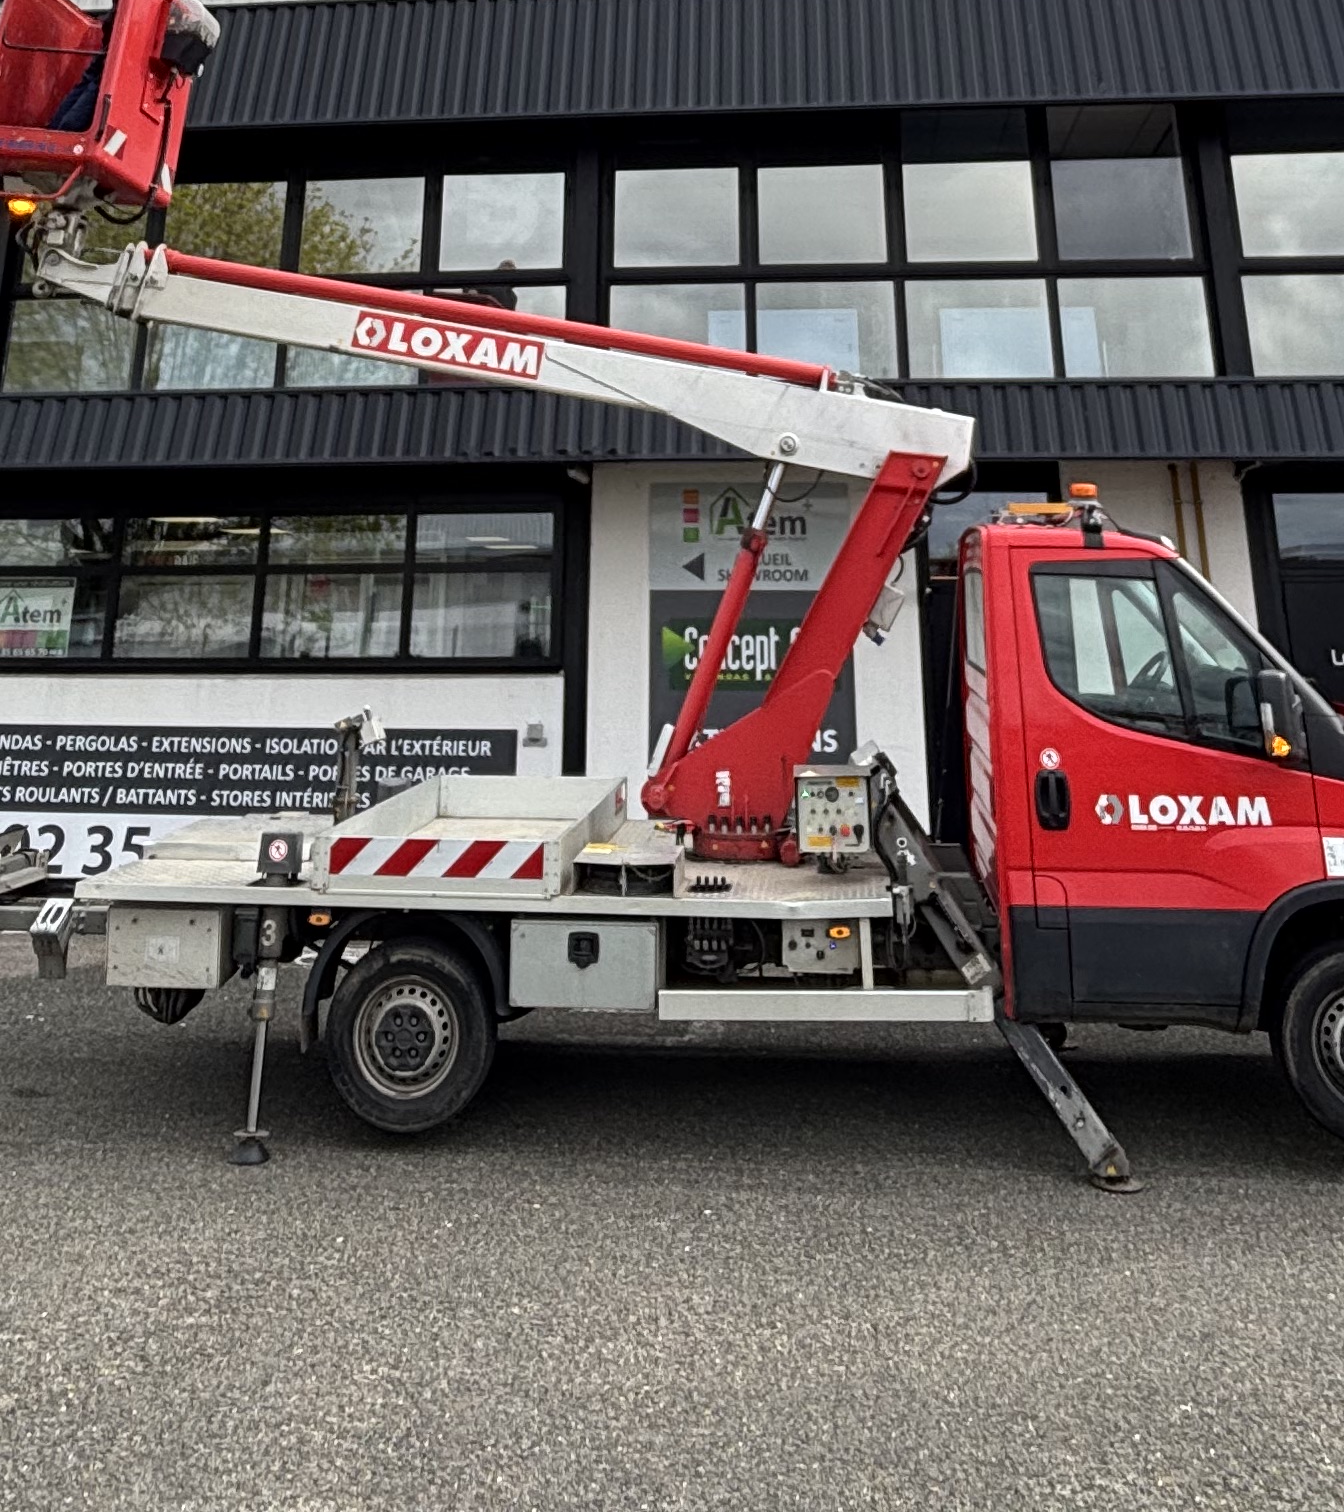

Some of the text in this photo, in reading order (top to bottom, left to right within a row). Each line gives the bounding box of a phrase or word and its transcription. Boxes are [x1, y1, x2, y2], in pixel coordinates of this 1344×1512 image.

[387, 321, 539, 375] LOXAM
[56, 736, 138, 752] PERGOLAS
[151, 736, 251, 754] EXTENSIONS
[265, 737, 339, 755] ISOLATIO
[62, 761, 123, 778] PORTES
[127, 757, 204, 779] D'ENTRÉE
[218, 763, 295, 781] PORTAILS
[375, 765, 397, 782] DE
[14, 786, 100, 804] ROULANTS
[116, 788, 197, 806] BATTANTS
[210, 789, 272, 808] STORES
[1128, 795, 1273, 826] LOXAM
[80, 825, 152, 876] 35
[261, 919, 277, 947] 3
